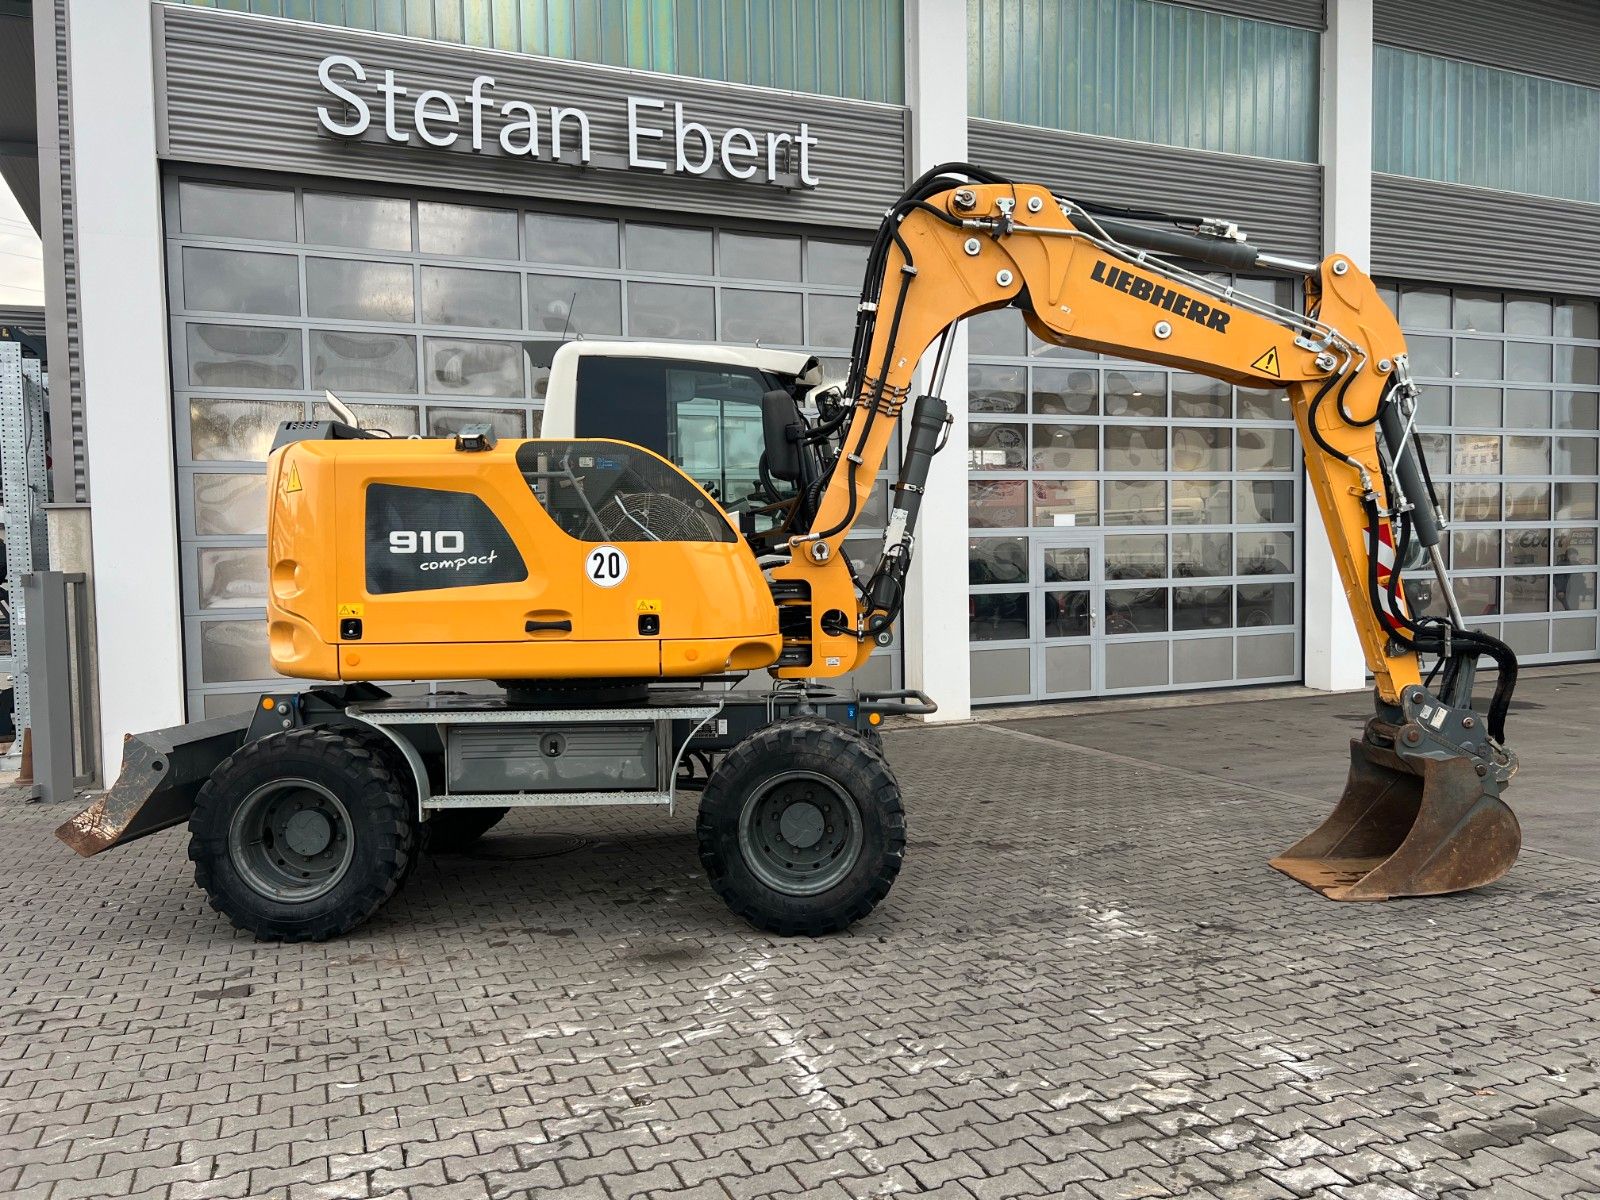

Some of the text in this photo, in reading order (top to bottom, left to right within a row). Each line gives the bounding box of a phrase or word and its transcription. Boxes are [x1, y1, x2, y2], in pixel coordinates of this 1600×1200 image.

[317, 55, 819, 187] Stefan Ebert
[1090, 260, 1231, 334] LIEBHERR
[389, 530, 465, 554] 910
[420, 549, 498, 571] compact
[593, 552, 620, 579] 20
